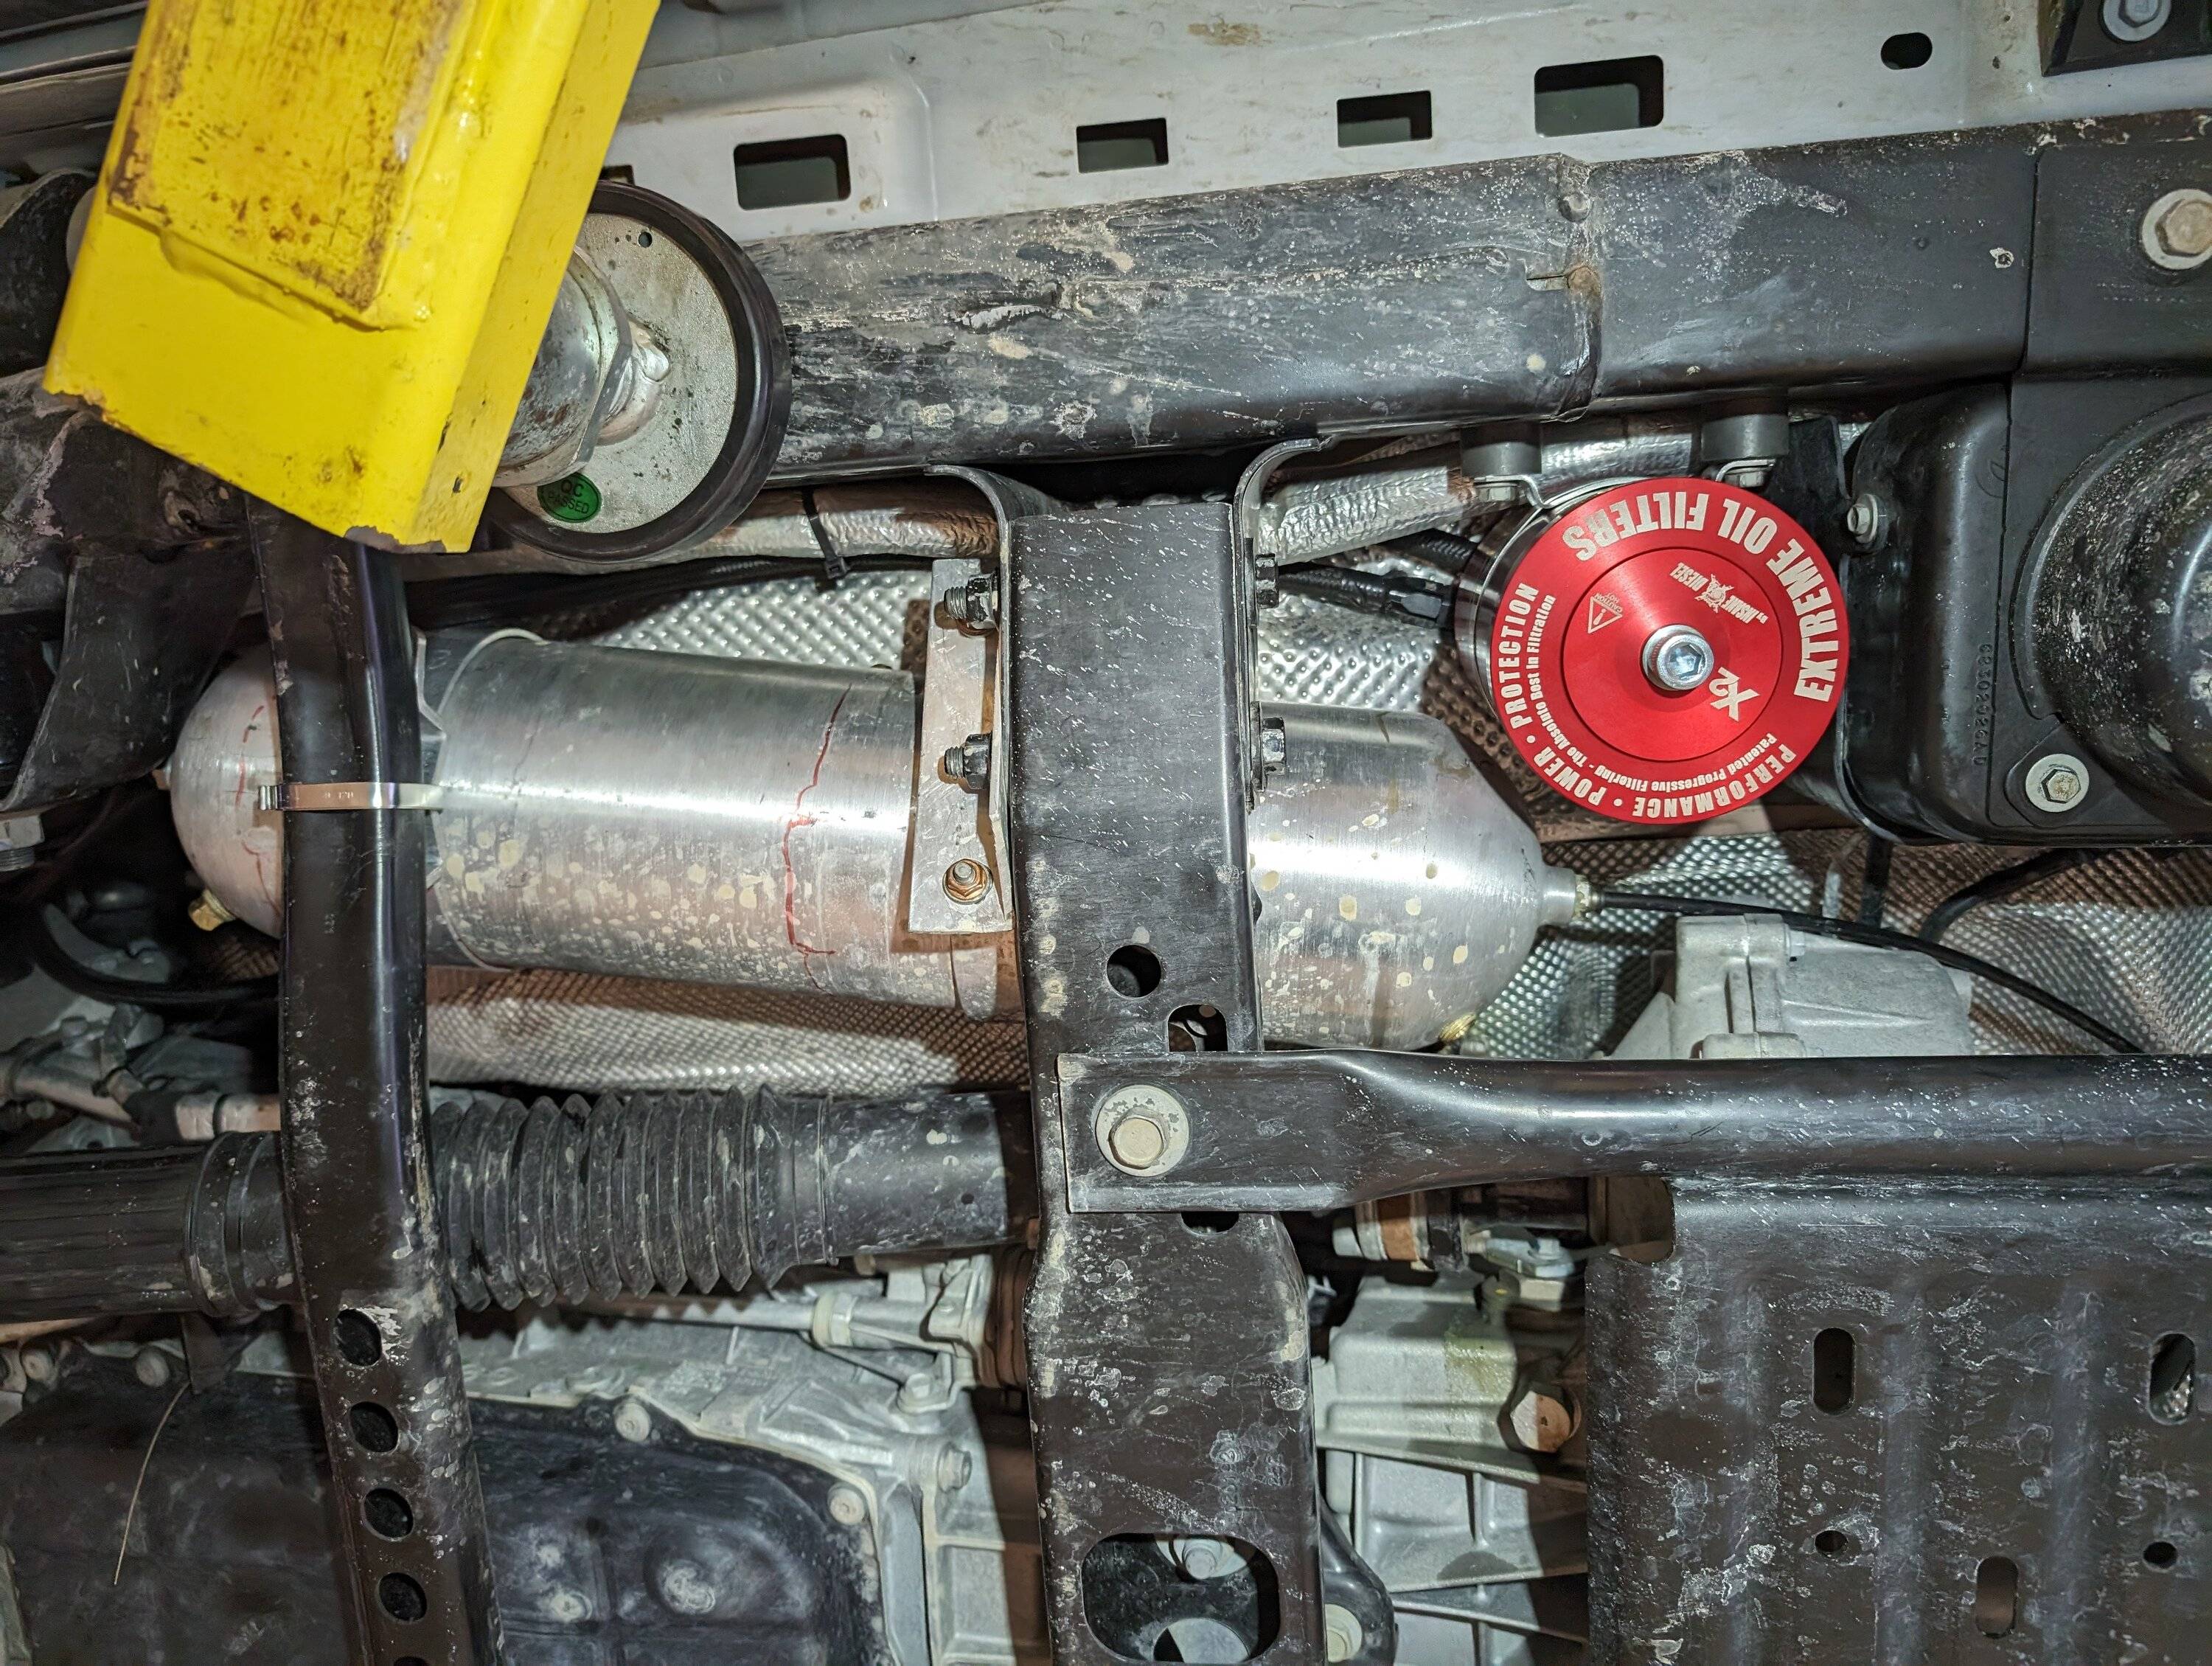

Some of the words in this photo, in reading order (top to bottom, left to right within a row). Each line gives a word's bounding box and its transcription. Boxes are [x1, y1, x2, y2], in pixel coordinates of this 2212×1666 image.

[548, 492, 590, 514] PASSED
[560, 479, 585, 498] QC
[1562, 490, 1710, 562] FILTERS
[1717, 498, 1778, 555] OIL
[1669, 562, 1708, 591] DIESEL
[1526, 594, 1557, 653] Filtration
[1593, 592, 1623, 613] CAUTION
[1722, 594, 1759, 624] INSANE
[1765, 538, 1839, 702] EXTREME
[1498, 582, 1540, 729] PROTECTION
[1527, 672, 1544, 701] Best
[1709, 667, 1760, 722] X2
[1535, 701, 1571, 750] Absolute
[1533, 746, 1607, 806] POWER
[1566, 746, 1587, 768] The
[1726, 732, 1778, 776] Patented
[1593, 765, 1649, 792] Filtering
[1632, 743, 1797, 819] PERFORMANCE
[1651, 768, 1728, 793] Progressive
